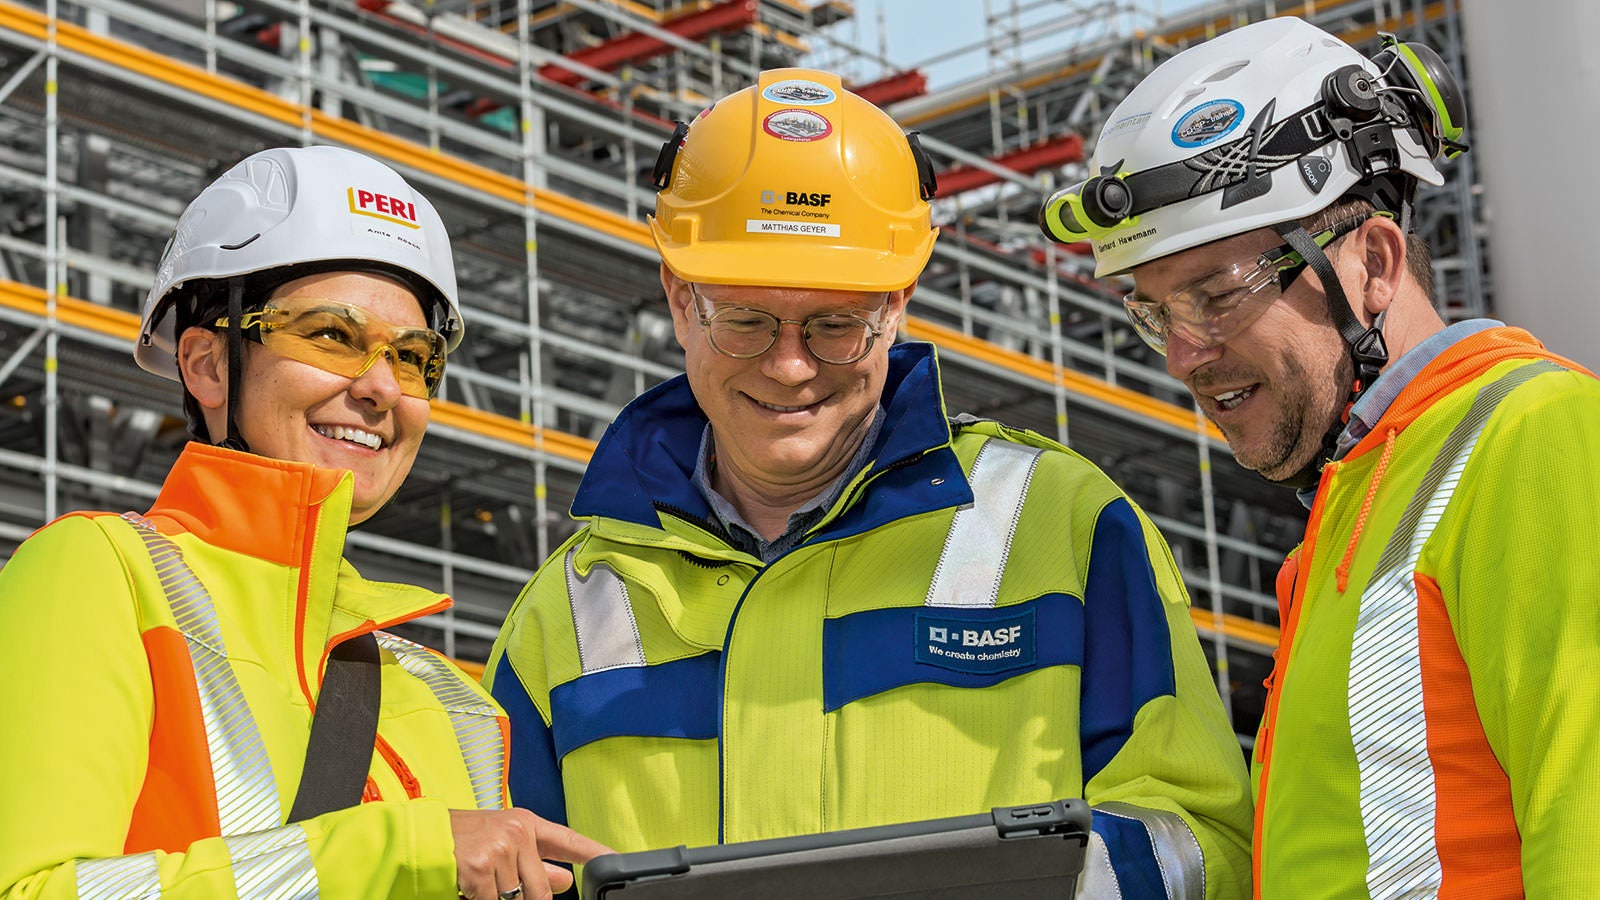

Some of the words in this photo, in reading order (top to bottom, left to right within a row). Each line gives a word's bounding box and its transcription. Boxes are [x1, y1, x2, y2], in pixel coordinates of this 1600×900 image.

[1303, 163, 1318, 186] VISOR
[358, 189, 416, 221] PERI
[786, 192, 831, 207] BASF
[773, 208, 800, 217] Chemical
[801, 210, 830, 219] Company
[761, 223, 799, 232] MATTHIAS
[800, 225, 827, 234] GEYER
[1118, 227, 1157, 245] Hawemann
[962, 625, 1021, 647] BASF
[928, 645, 943, 656] We
[945, 648, 975, 661] create
[976, 647, 1021, 661] chemistry
